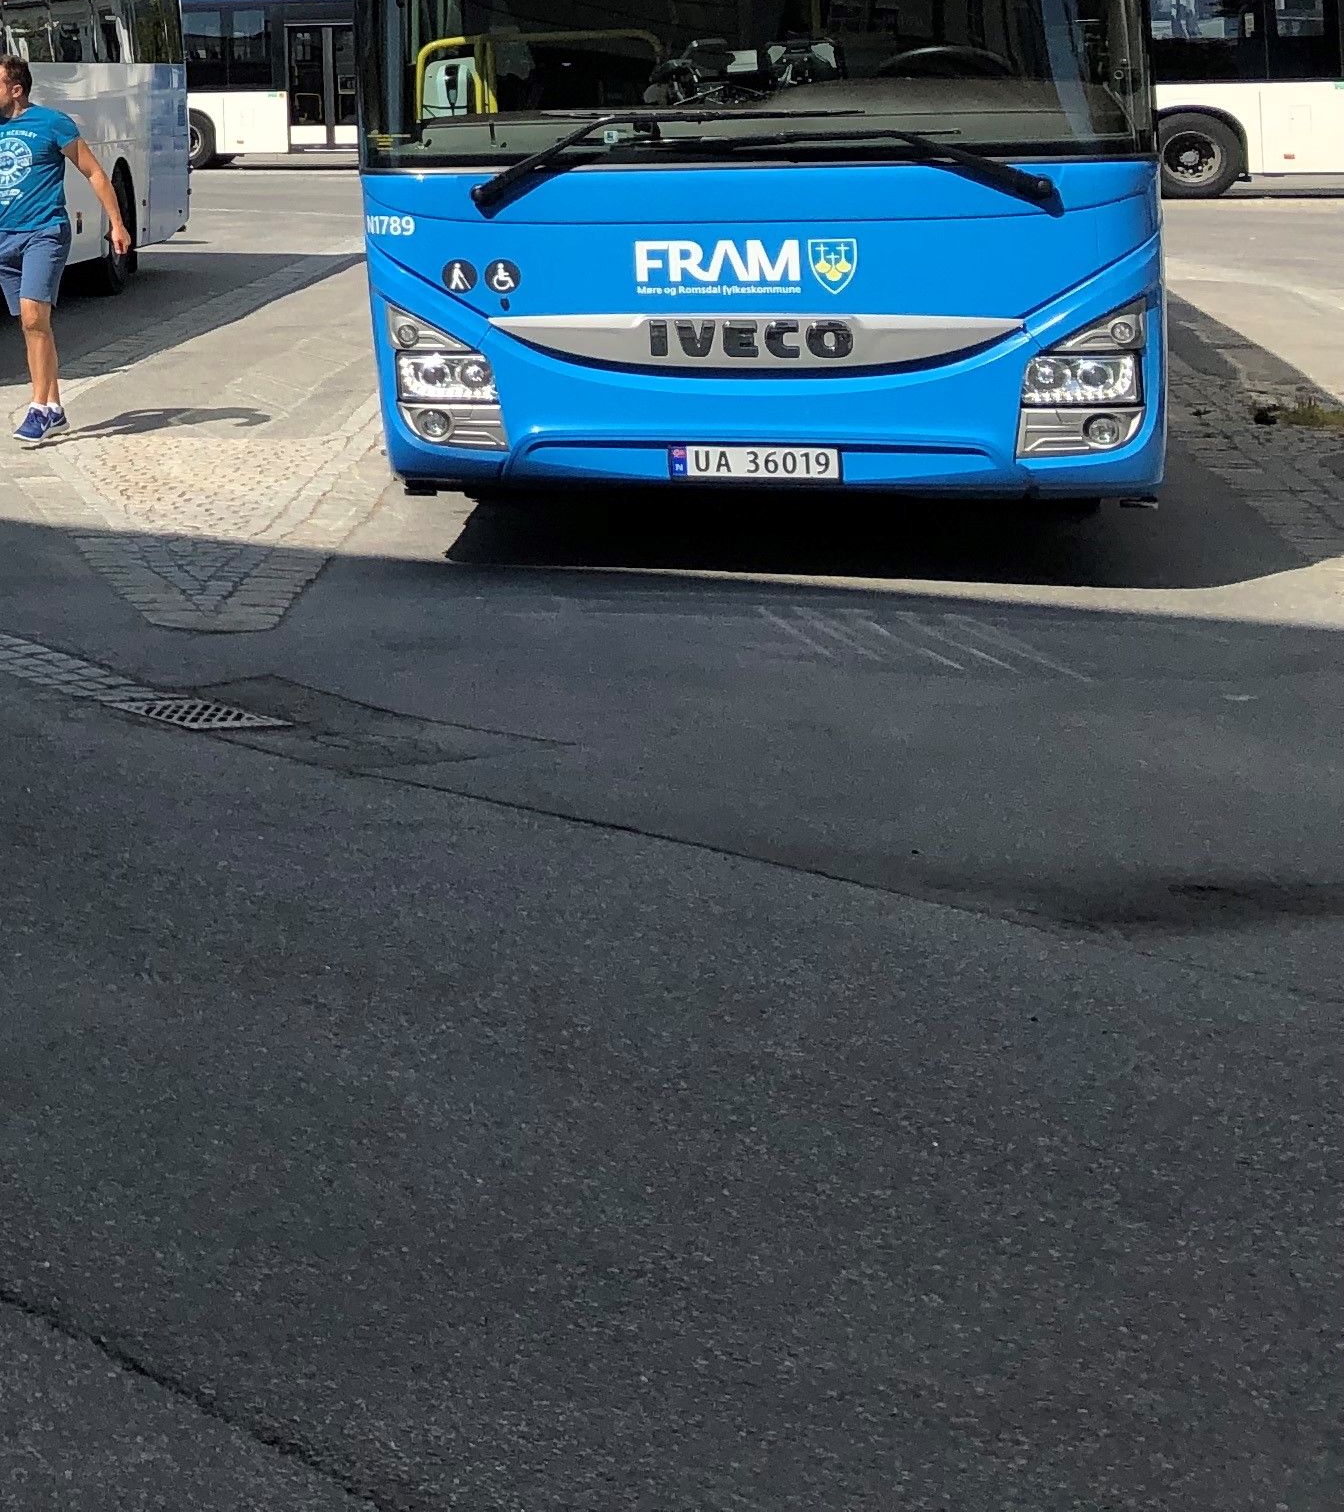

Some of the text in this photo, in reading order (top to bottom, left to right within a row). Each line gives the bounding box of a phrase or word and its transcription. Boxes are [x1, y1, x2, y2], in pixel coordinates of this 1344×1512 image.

[366, 214, 416, 236] N1789
[635, 239, 801, 282] FRAM
[664, 287, 677, 296] og
[678, 285, 721, 294] Romsdal
[649, 319, 854, 359] IVECO
[694, 445, 831, 475] UA 36019
